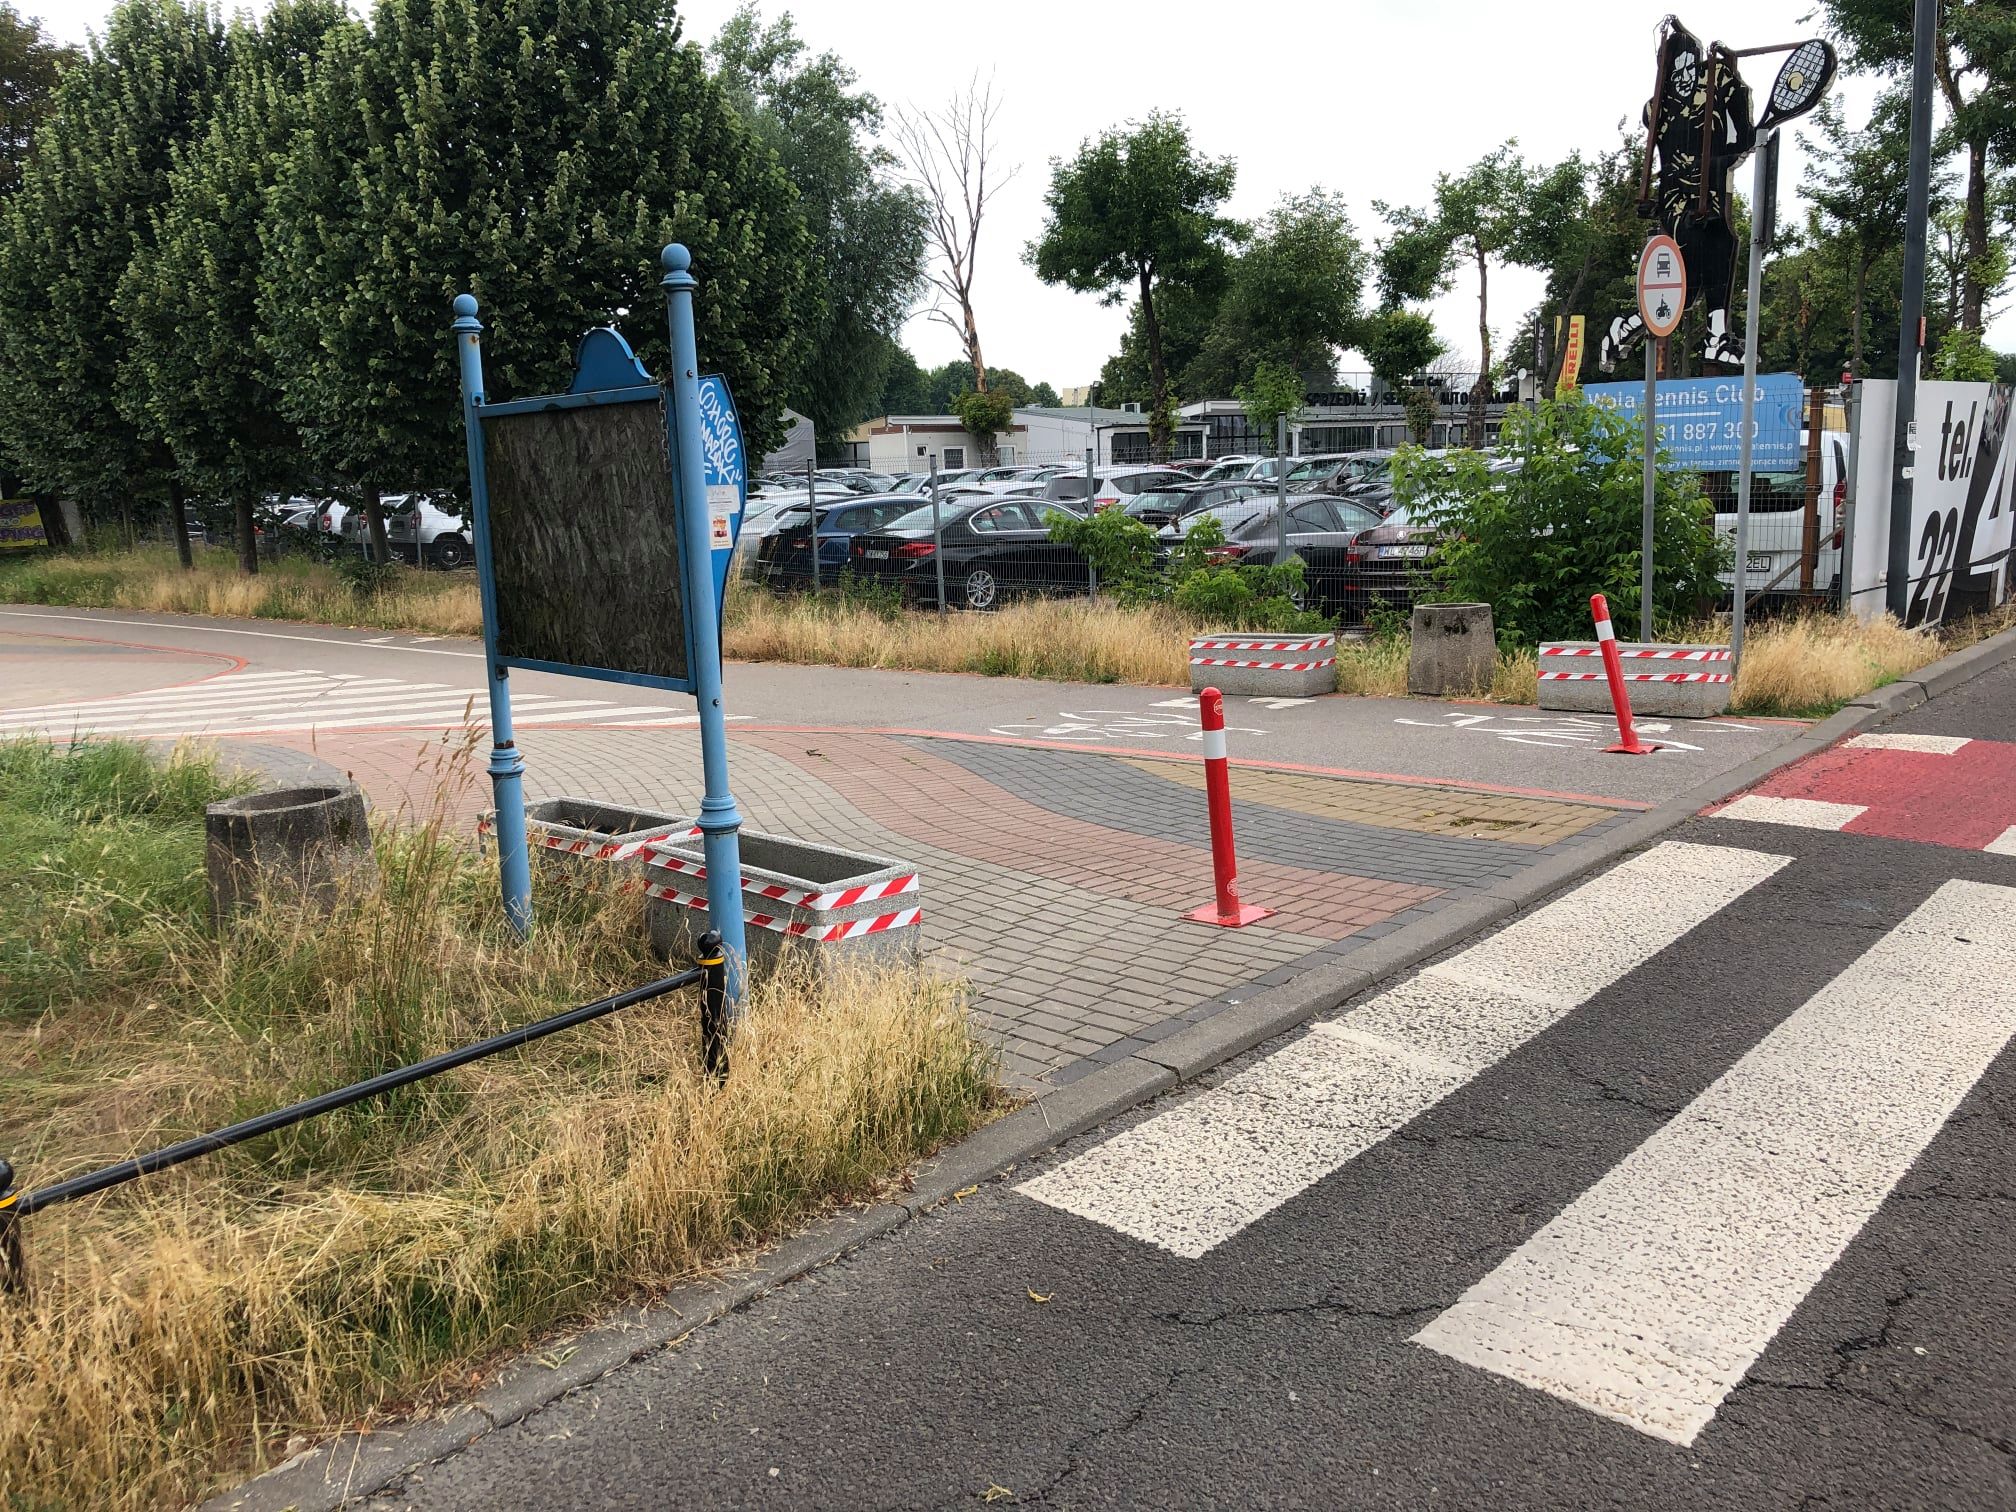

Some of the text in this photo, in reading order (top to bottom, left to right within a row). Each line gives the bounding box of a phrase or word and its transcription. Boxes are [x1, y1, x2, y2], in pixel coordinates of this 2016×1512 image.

[1642, 386, 1708, 407] ennis
[1683, 423, 1717, 441] 887
[1939, 400, 1978, 481] tel.
[1905, 507, 1959, 629] 22
